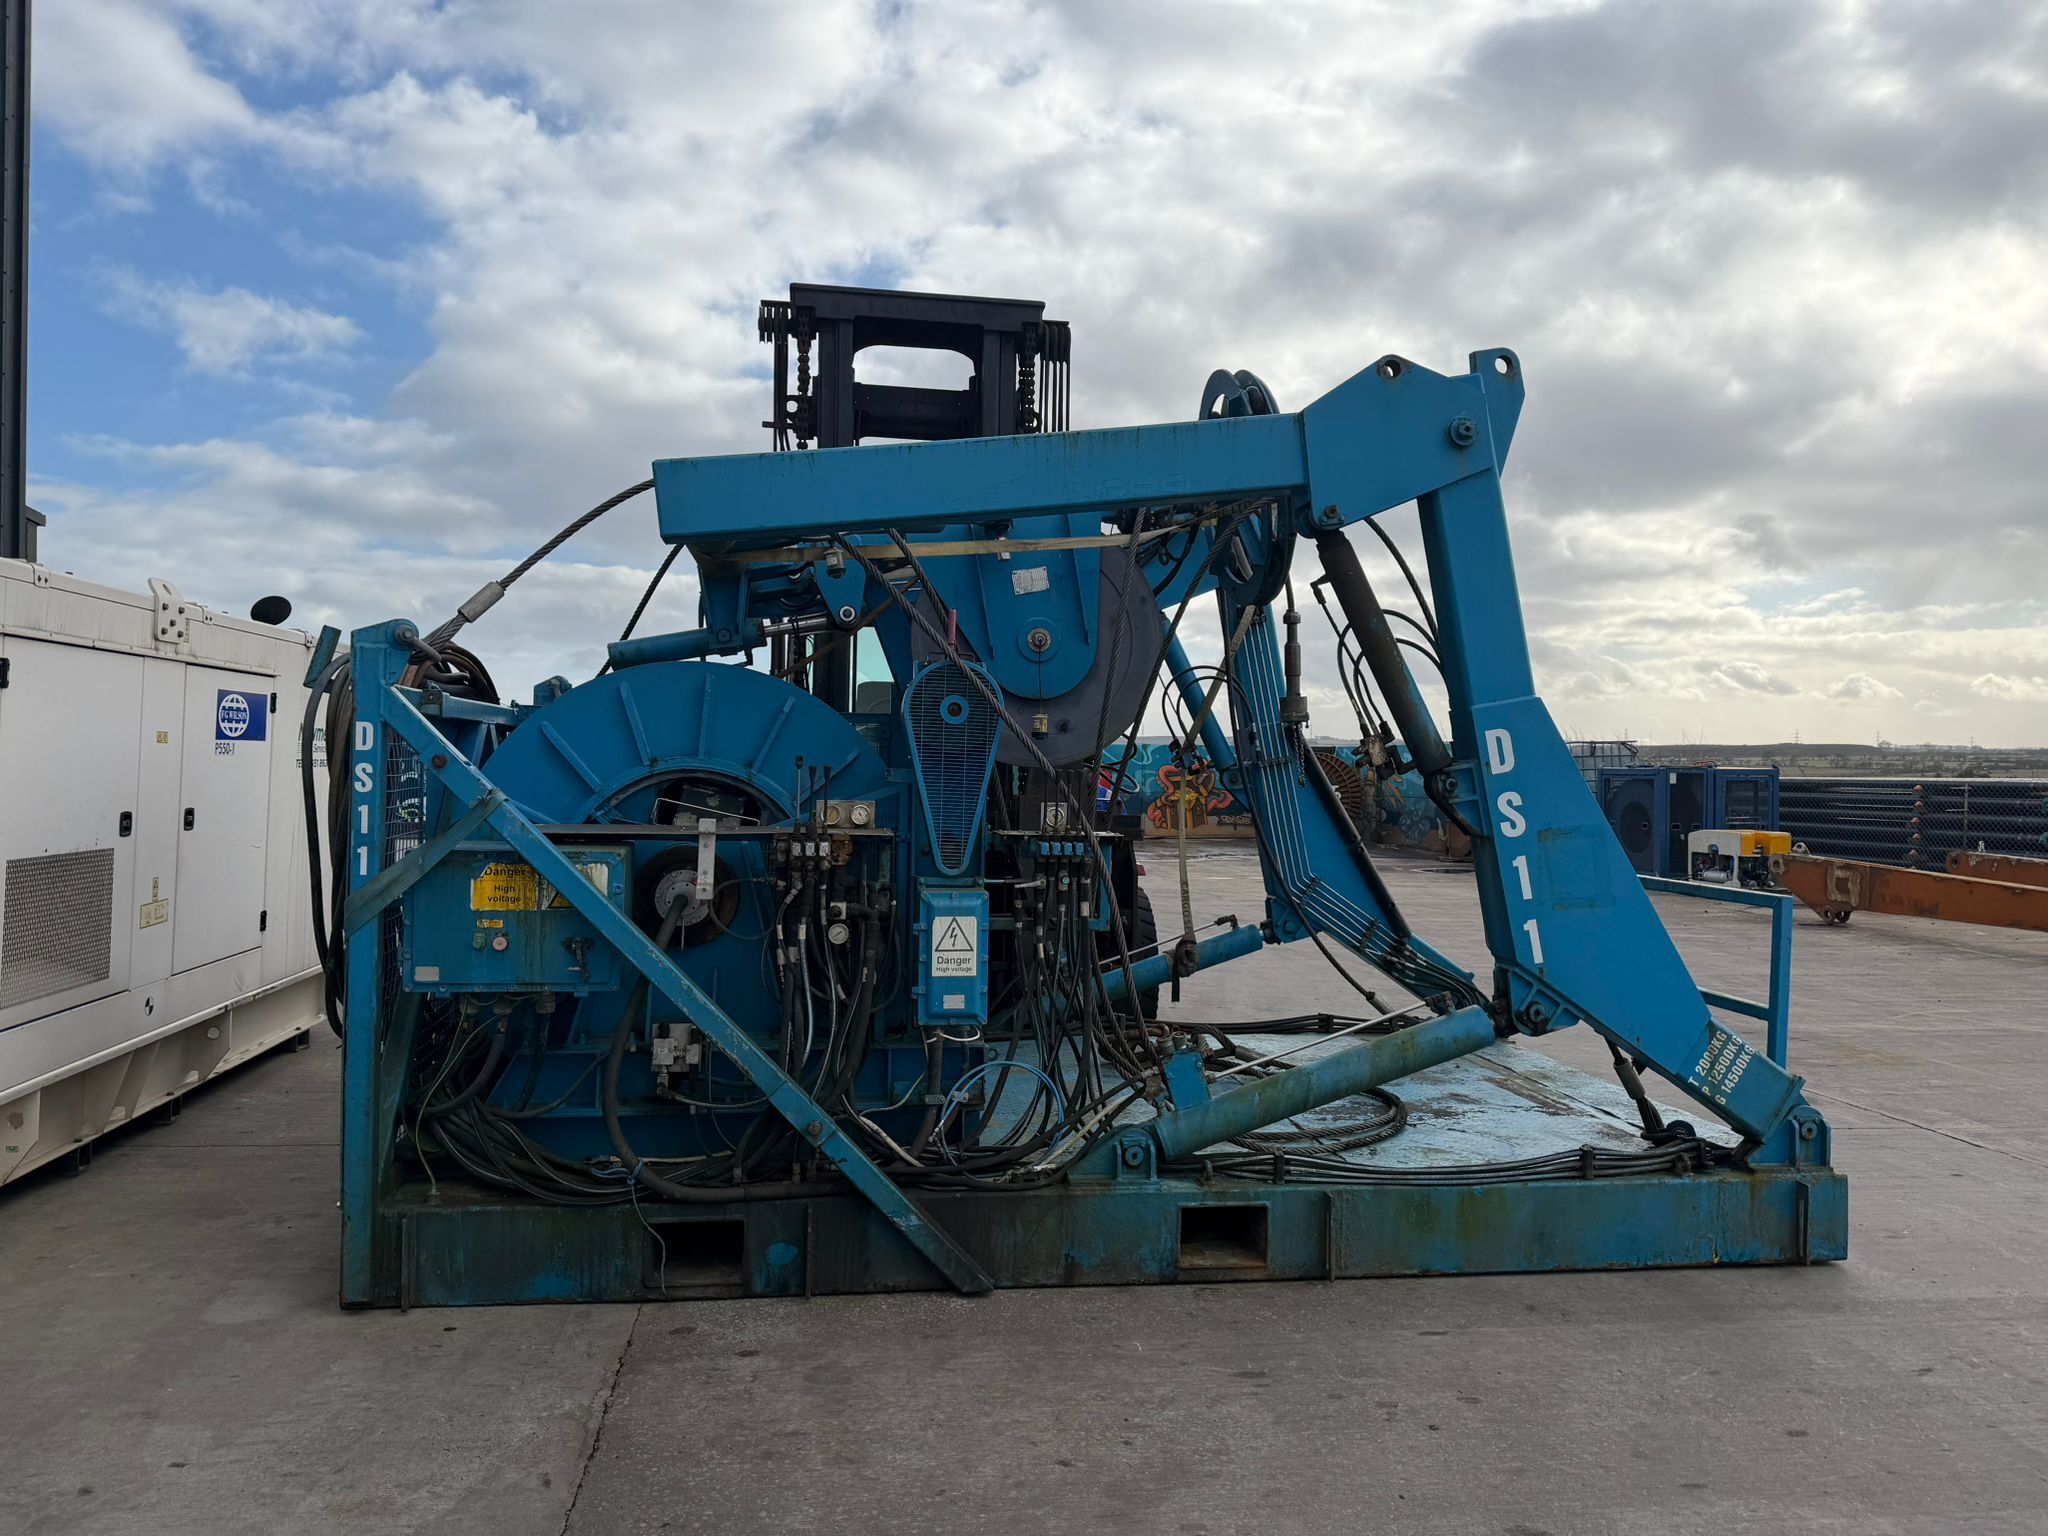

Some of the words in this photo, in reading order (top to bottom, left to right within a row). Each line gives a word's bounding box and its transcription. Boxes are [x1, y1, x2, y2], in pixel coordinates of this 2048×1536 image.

[1485, 728, 1544, 965] DS11
[485, 866, 526, 877] Danger
[487, 895, 521, 903] voltage
[494, 885, 515, 894] High
[937, 956, 972, 966] Danger
[1695, 1031, 1727, 1076] 2000KG
[1708, 1035, 1743, 1084] 12500KG
[1721, 1044, 1755, 1094] 14500KG
